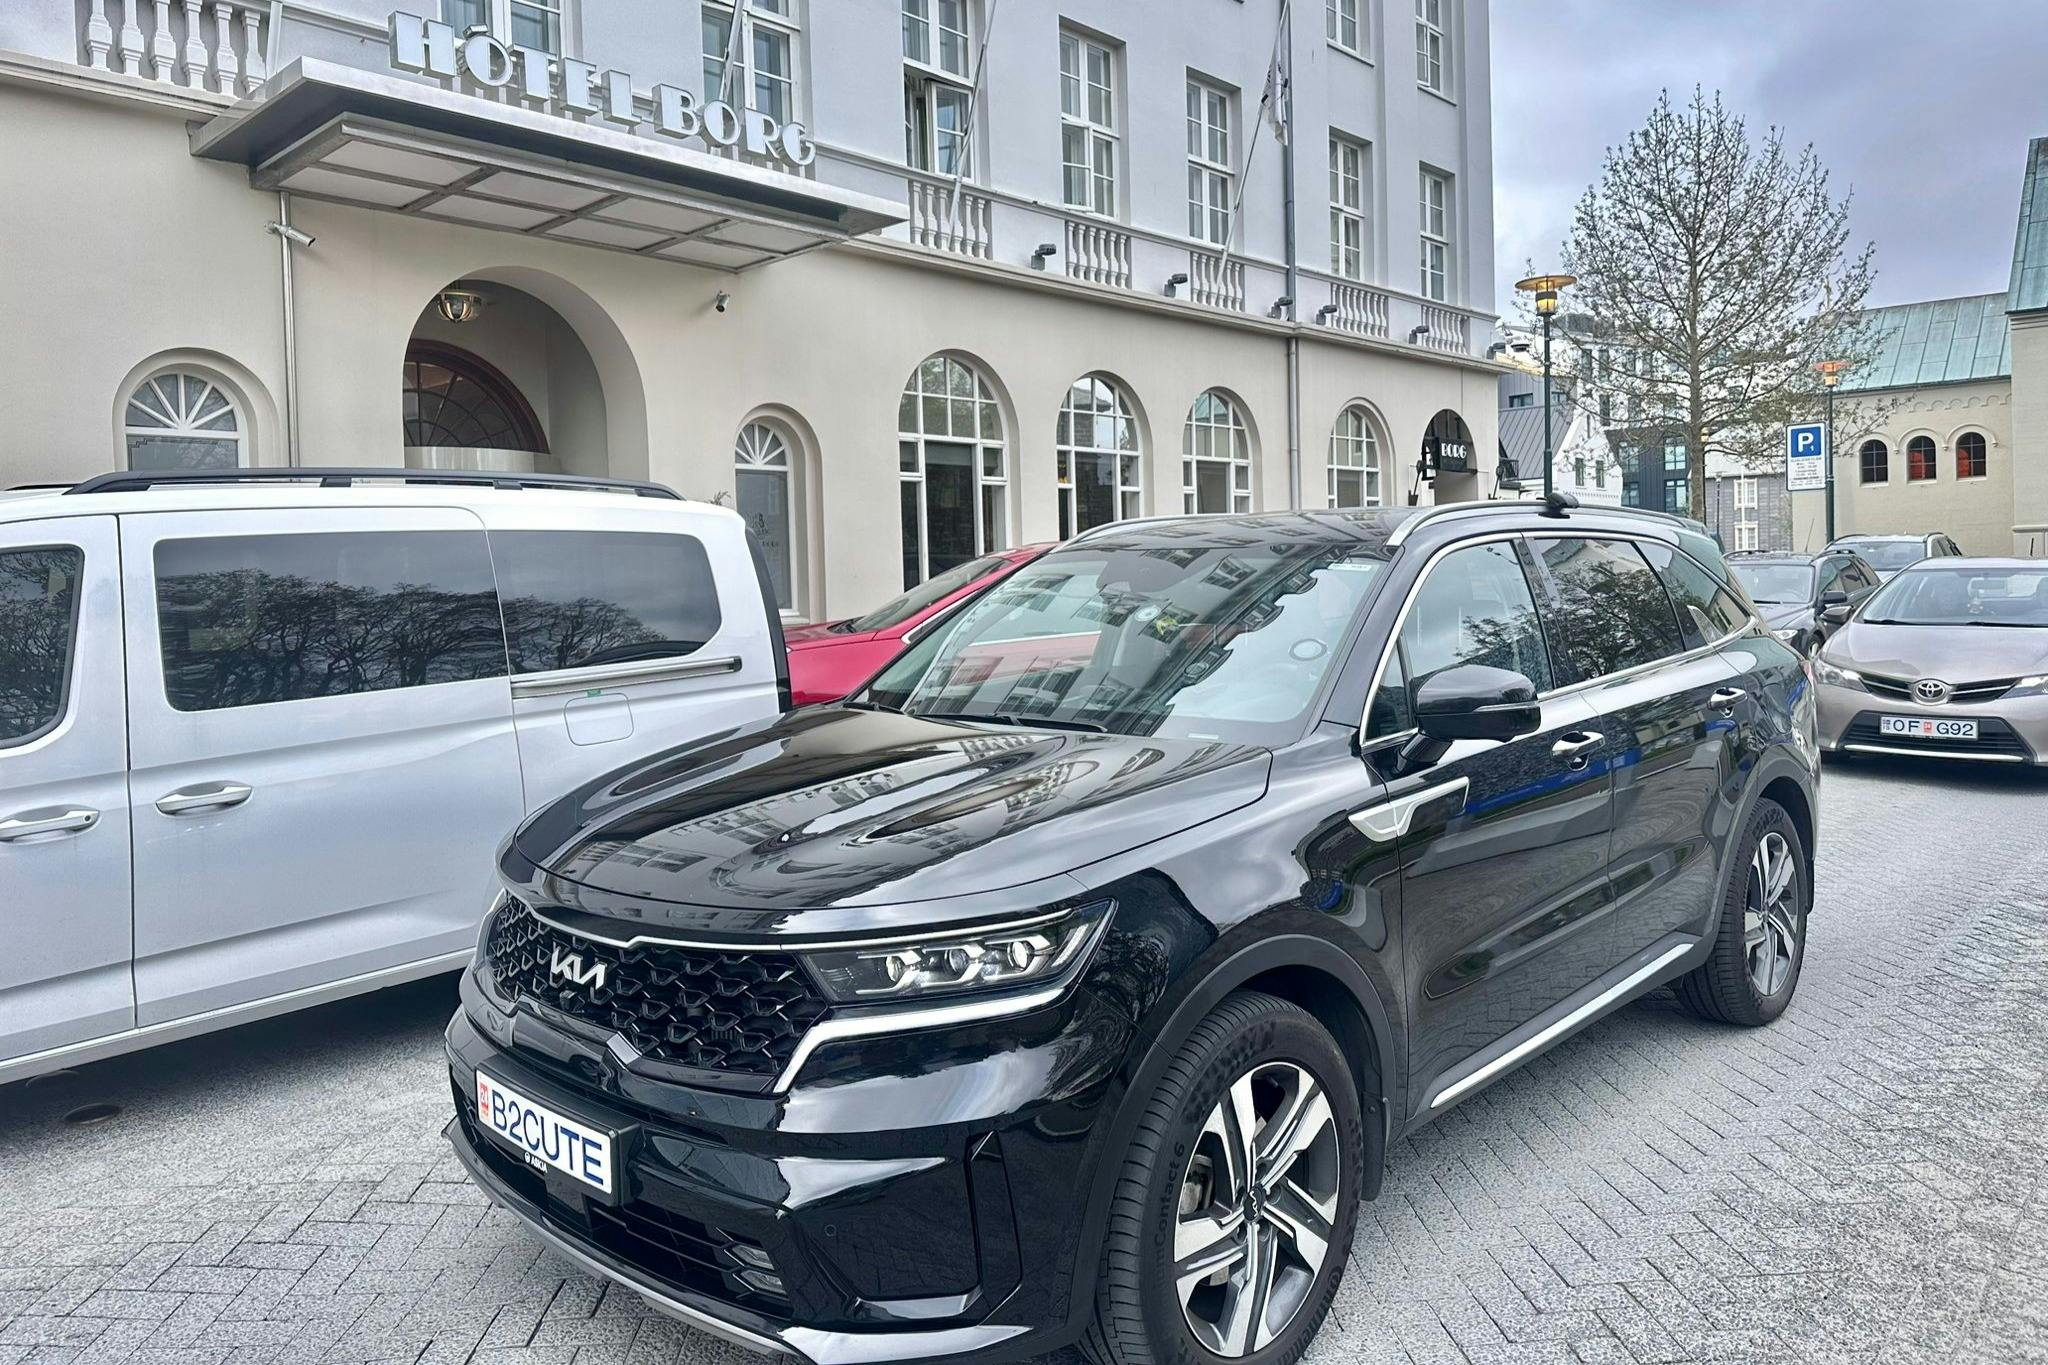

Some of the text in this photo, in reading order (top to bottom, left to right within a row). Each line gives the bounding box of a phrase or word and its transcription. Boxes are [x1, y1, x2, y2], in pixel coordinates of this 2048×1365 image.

[388, 10, 816, 166] HÓTEL BORG
[1441, 443, 1467, 459] BORG
[1797, 432, 1814, 453] P
[1893, 719, 1920, 732] OF
[1936, 722, 1974, 736] G92
[491, 1089, 604, 1186] B2CUTE
